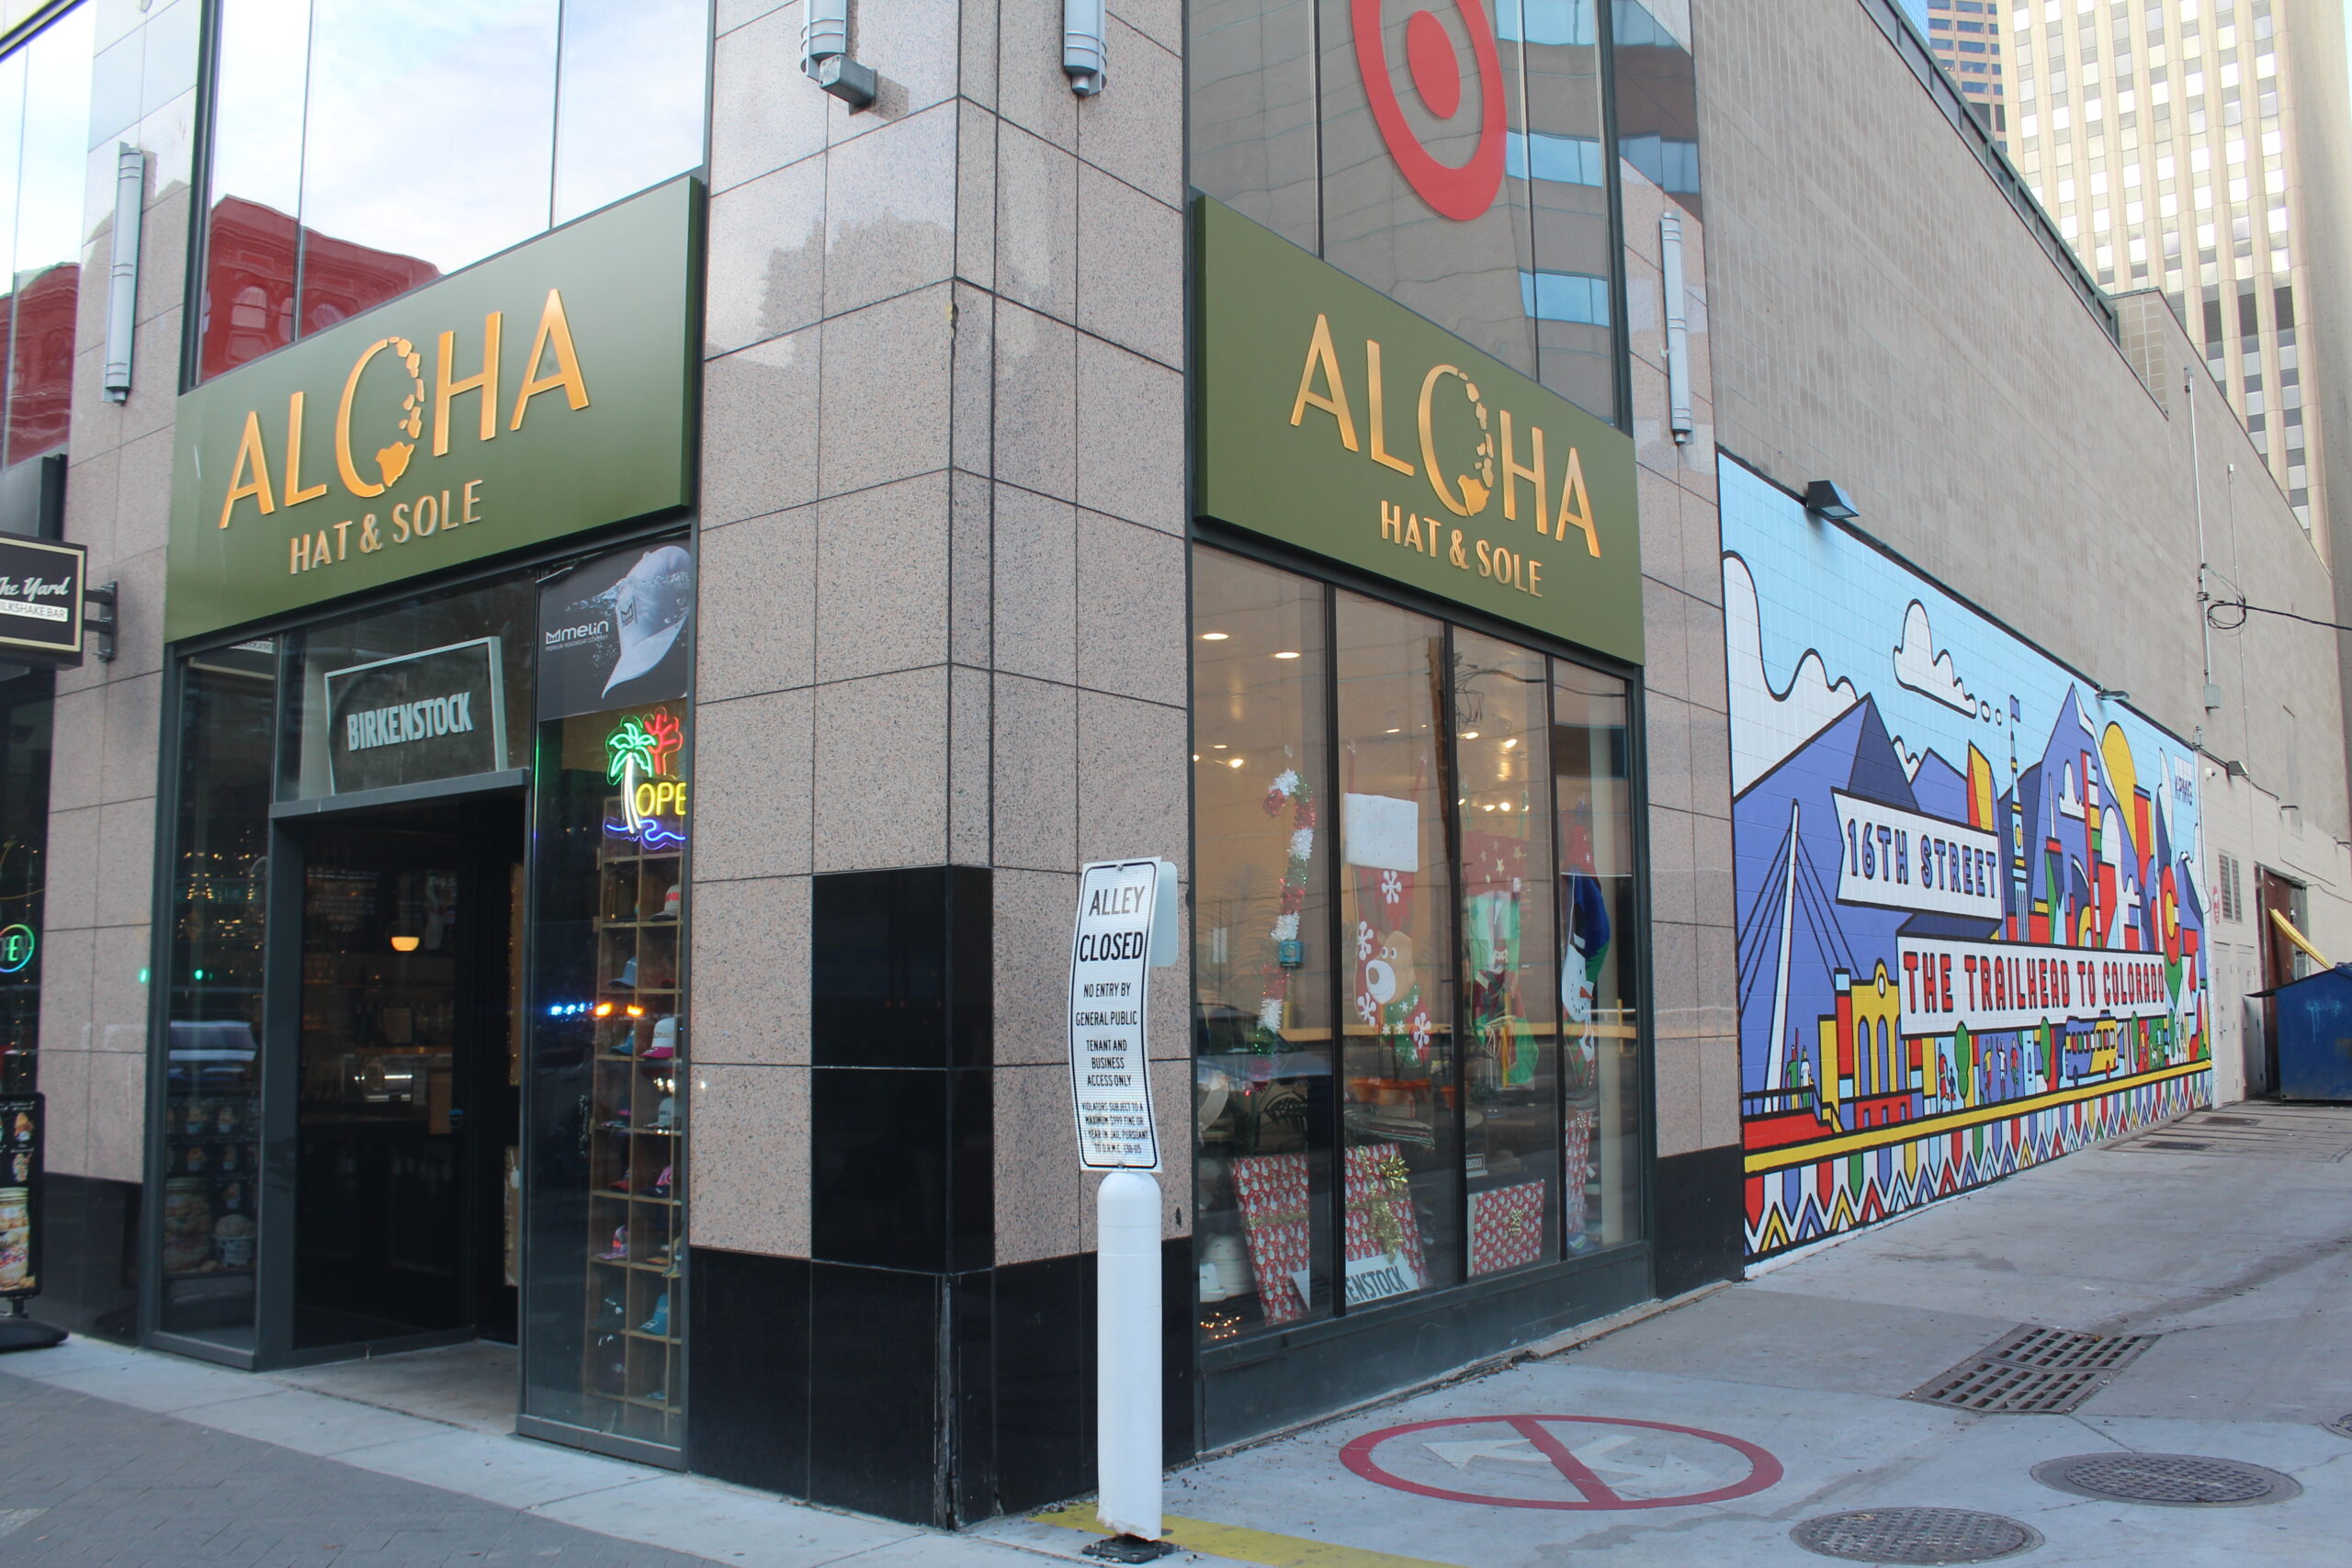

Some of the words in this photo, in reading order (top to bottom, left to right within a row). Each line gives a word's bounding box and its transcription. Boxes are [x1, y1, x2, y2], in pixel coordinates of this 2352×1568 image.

[219, 288, 590, 529] ALOHA
[1290, 313, 1601, 558] ALOHA
[289, 520, 353, 575] HAT
[359, 513, 383, 554] &
[392, 479, 483, 545] SOLE
[1381, 500, 1442, 558] HAT
[1449, 529, 1470, 570] &
[1476, 539, 1543, 597] SOLE
[23, 576, 72, 603] Yard
[0, 601, 45, 616] ILKSHAKE
[47, 607, 66, 619] BAR
[561, 620, 609, 641] melin
[346, 691, 473, 752] BIRKENSTOCK
[2175, 774, 2193, 807] KPMG
[1847, 818, 1909, 885] 16TH
[1920, 835, 1996, 898] STREET
[1088, 886, 1146, 916] ALLEY
[1080, 931, 1143, 962] CLOSED
[1083, 984, 1094, 998] NO
[1096, 983, 1120, 998] ENTRY
[1121, 982, 1131, 997] BY
[1903, 951, 1953, 1014] THE
[1964, 954, 2070, 1011] TRAILHEAD
[2077, 961, 2095, 1008] TO
[2103, 961, 2165, 1008] COLORADO
[1076, 1011, 1109, 1026] GENERAL
[1111, 1010, 1137, 1025] PUBLIC
[1086, 1040, 1112, 1052] TENANT
[1113, 1039, 1127, 1052] AND
[1091, 1057, 1125, 1069] BUSINESS
[1087, 1075, 1114, 1087] ACCESS
[1114, 1075, 1132, 1087] ONLY
[1081, 1102, 1108, 1111] VIOLATORS
[1109, 1102, 1131, 1111] SUBJECT
[1132, 1102, 1138, 1111] TO
[1139, 1102, 1144, 1111] A
[1085, 1116, 1108, 1124] MAXIMUM
[1124, 1116, 1135, 1125] FINE
[1136, 1116, 1144, 1125] OR
[1088, 1129, 1101, 1139] YEAR
[1102, 1130, 1108, 1139] IN
[1111, 1130, 1121, 1139] JAIL
[1123, 1130, 1148, 1139] PURSUANT
[1094, 1143, 1101, 1152] TO
